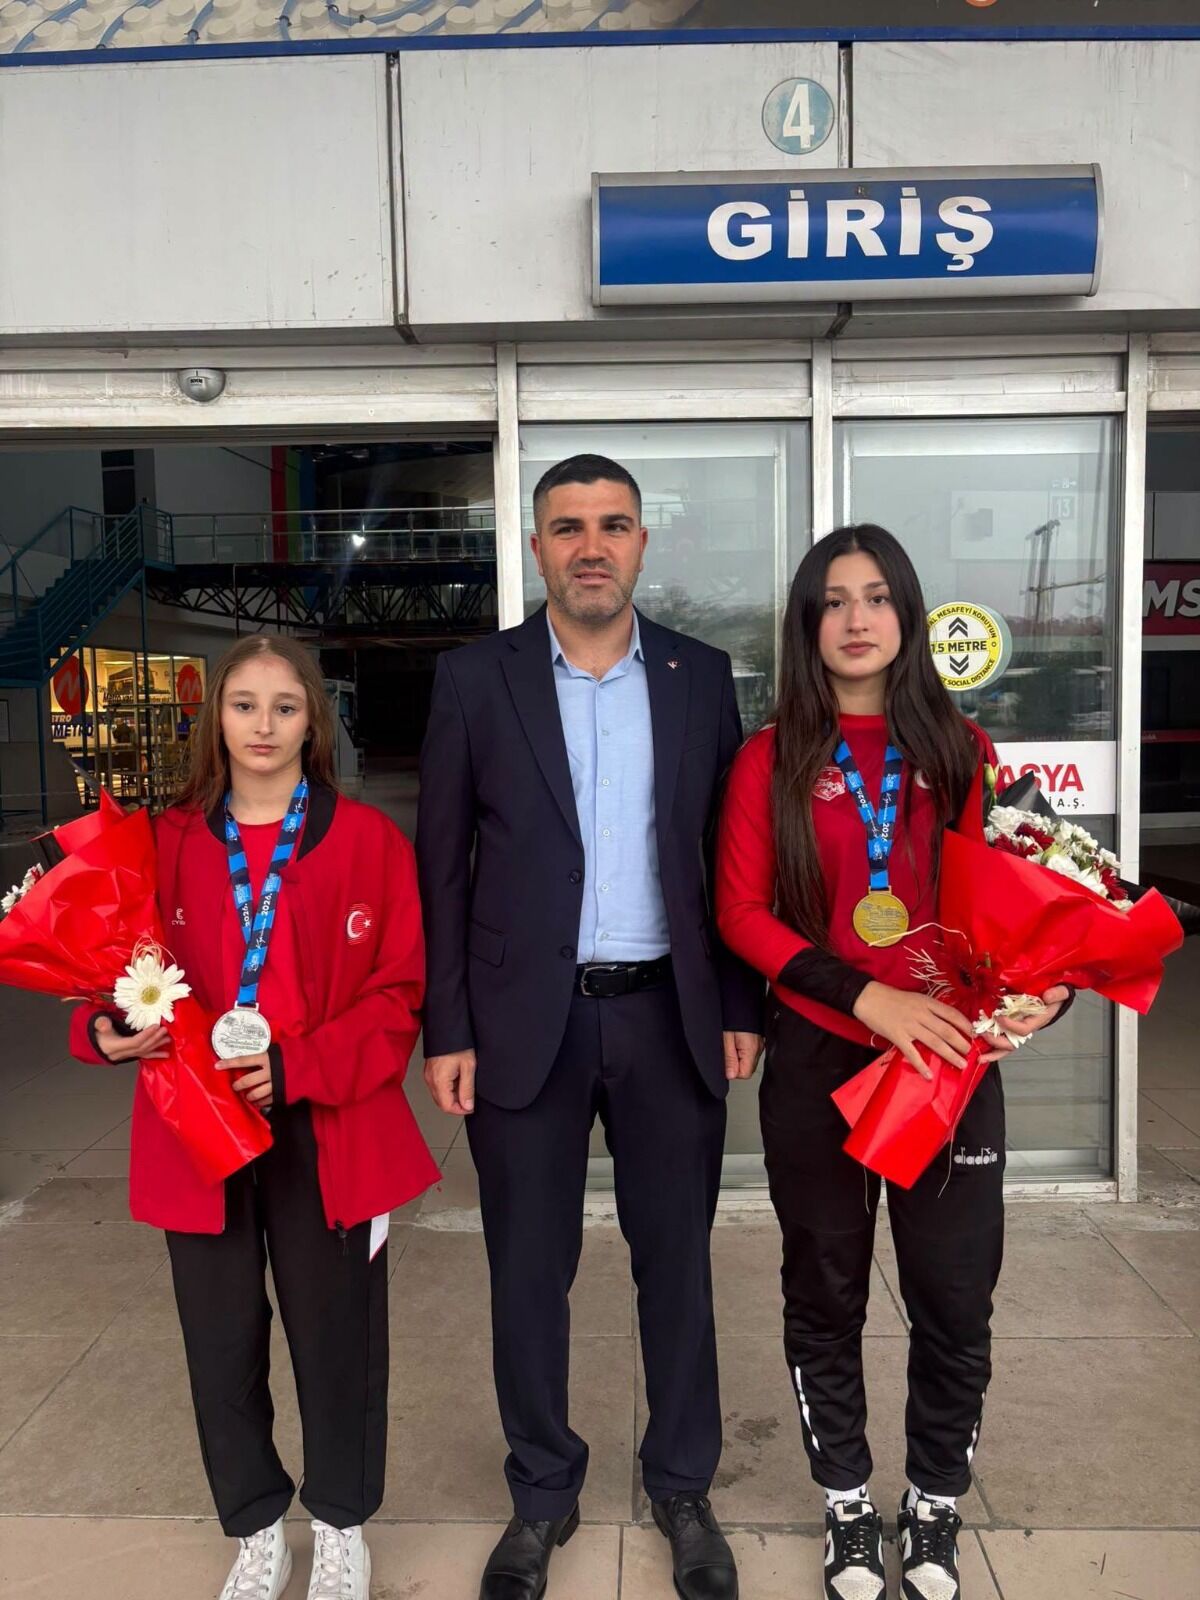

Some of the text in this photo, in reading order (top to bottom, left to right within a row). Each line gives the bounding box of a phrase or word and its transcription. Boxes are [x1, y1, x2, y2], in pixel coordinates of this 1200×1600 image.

[782, 84, 815, 148] 4
[707, 187, 994, 272] GİRİŞ
[948, 640, 987, 652] METRE
[947, 678, 972, 687] SOCIAL
[971, 657, 996, 683] DISTANCE
